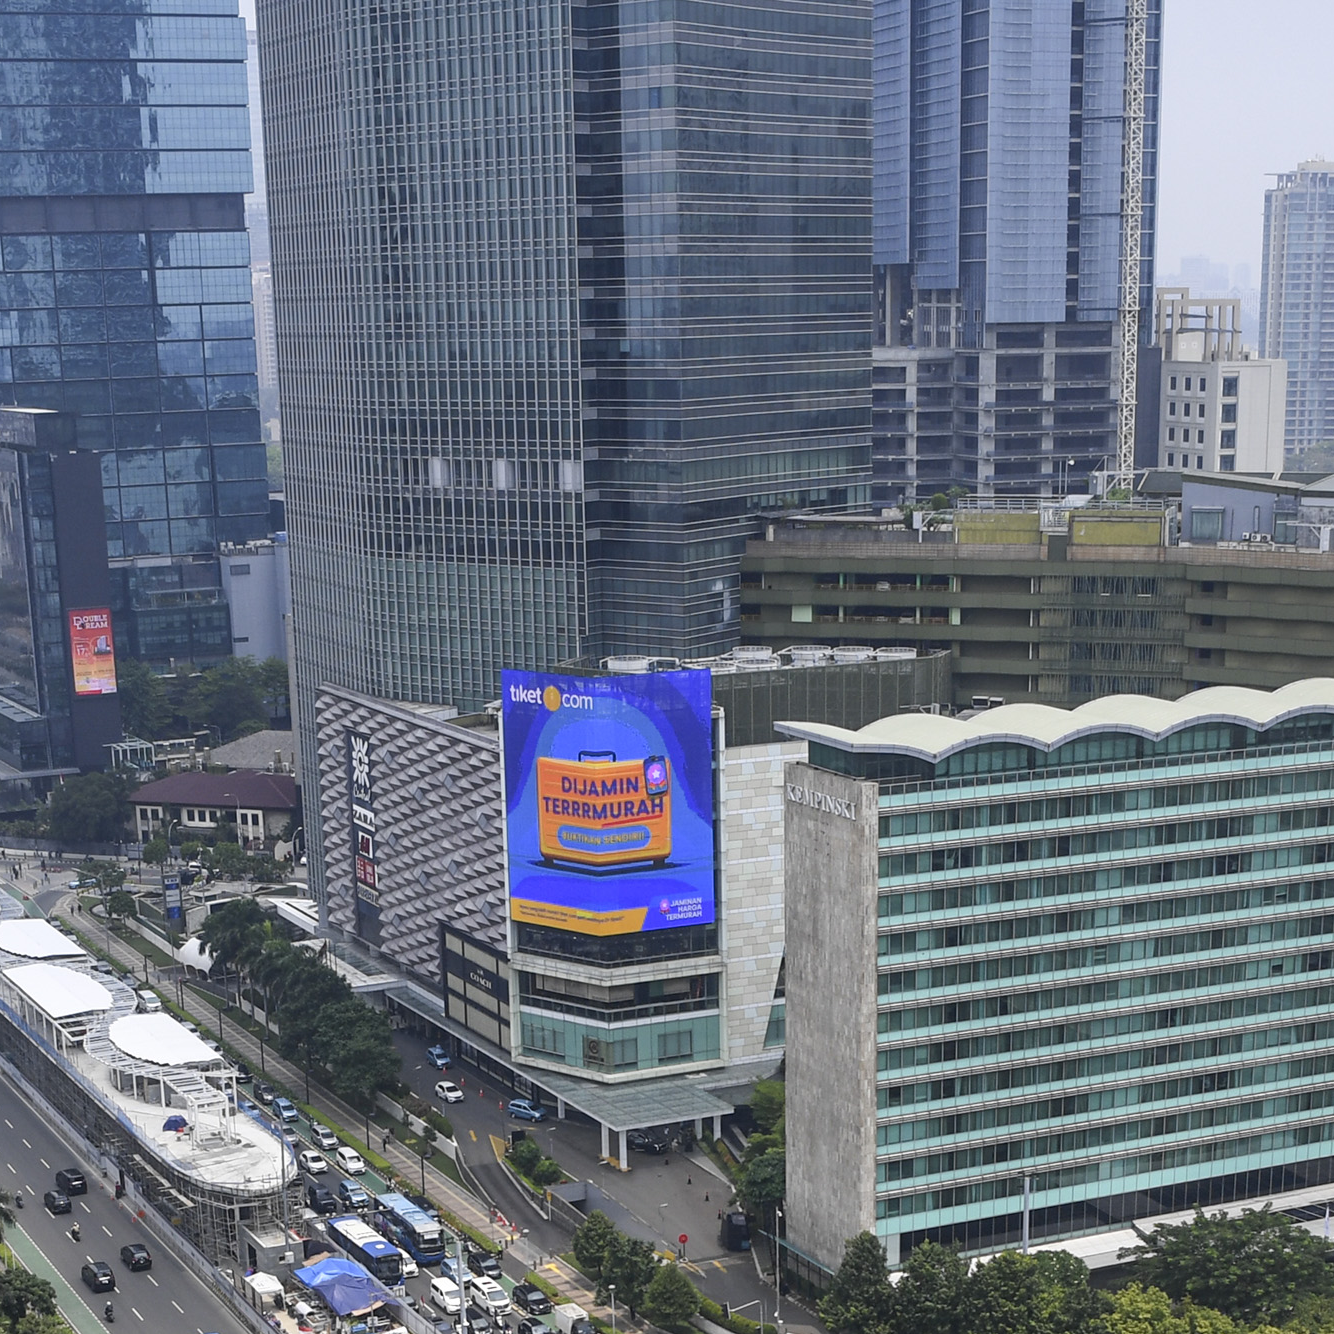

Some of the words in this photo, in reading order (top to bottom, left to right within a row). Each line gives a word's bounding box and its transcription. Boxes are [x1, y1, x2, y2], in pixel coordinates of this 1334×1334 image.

[561, 776, 639, 797] DIJAMIN
[543, 796, 664, 820] TERRRMURAH
[786, 783, 857, 821] KEMPINSKI
[670, 897, 703, 908] JAMINAN
[678, 904, 703, 914] HARGA
[666, 911, 703, 921] TERMURAH
[470, 972, 492, 990] COACH
